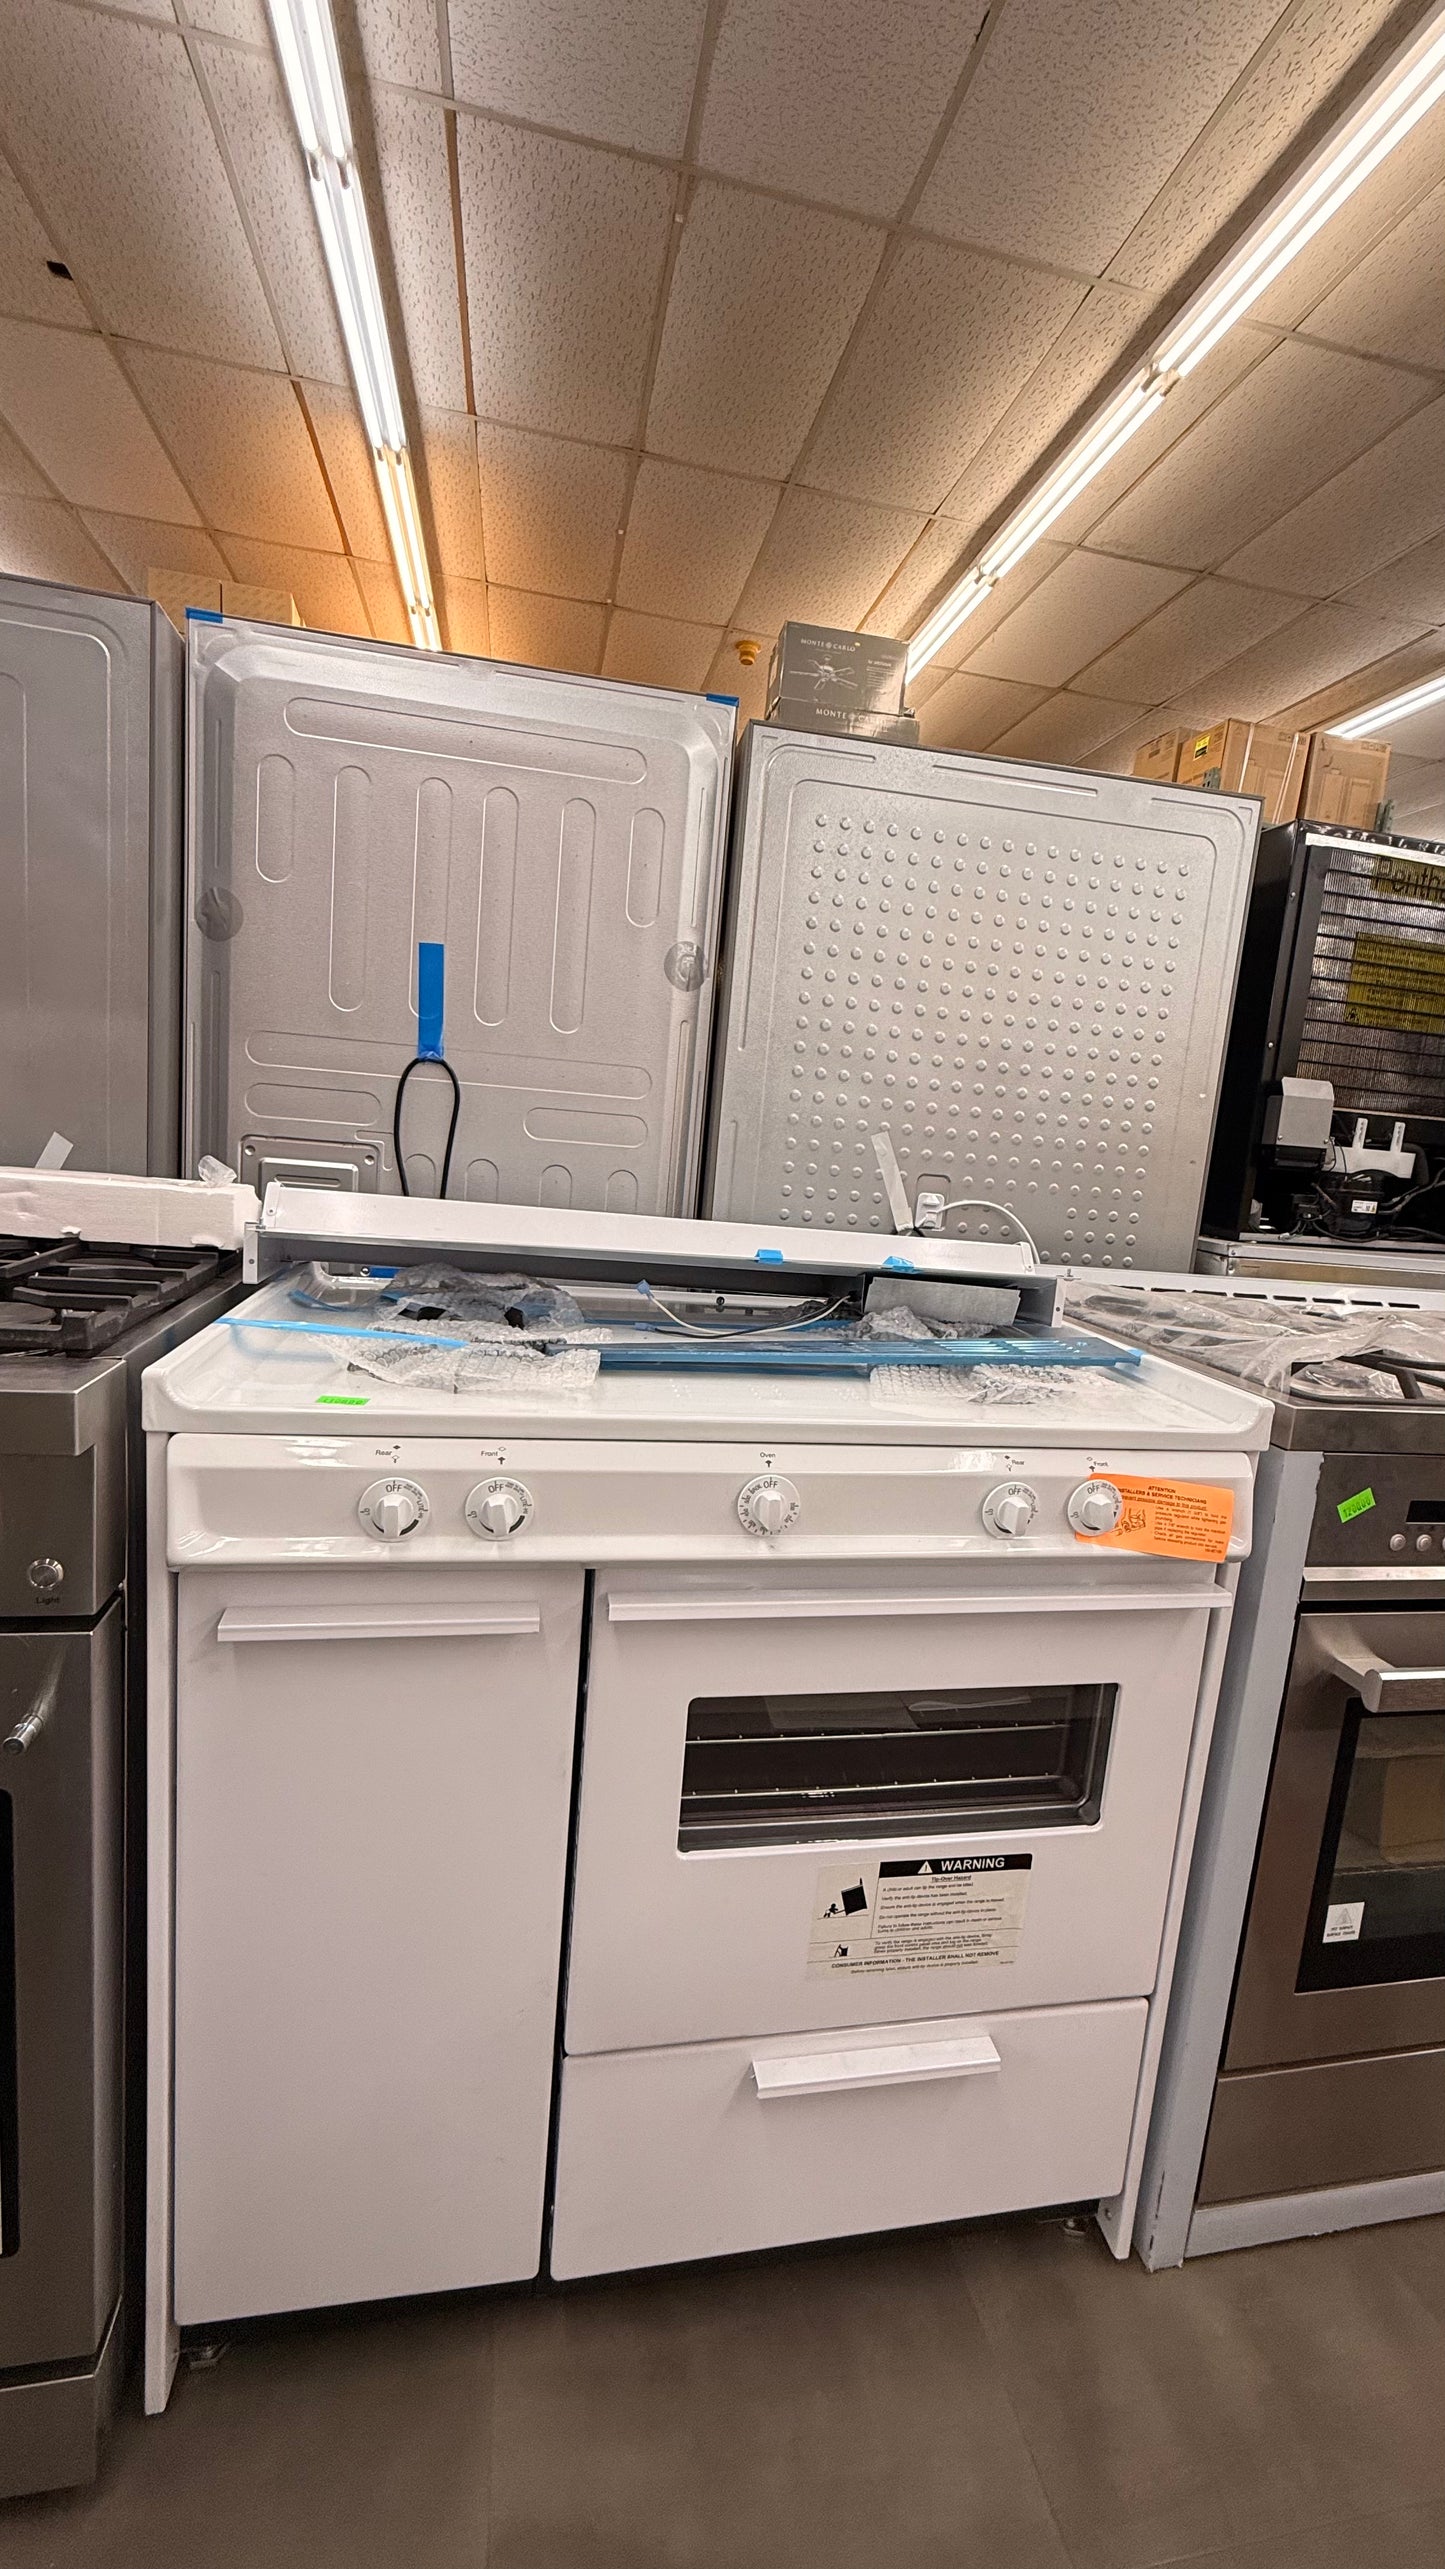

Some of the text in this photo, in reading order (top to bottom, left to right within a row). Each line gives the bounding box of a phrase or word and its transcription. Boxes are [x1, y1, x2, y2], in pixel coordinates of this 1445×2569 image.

[801, 638, 825, 648] MONTE
[833, 643, 856, 652] CARLO
[816, 708, 847, 719] MONTE
[385, 1484, 402, 1493] OFF
[488, 1483, 504, 1493] OFF
[763, 1480, 778, 1488] OFF
[1008, 1488, 1021, 1496] OFF
[1087, 1485, 1100, 1495] OFF
[1117, 1488, 1145, 1496] NSTALLERS
[1175, 1495, 1207, 1504] TECHNICIANS
[35, 1597, 60, 1605] Light
[940, 1857, 1005, 1872] WARNING
